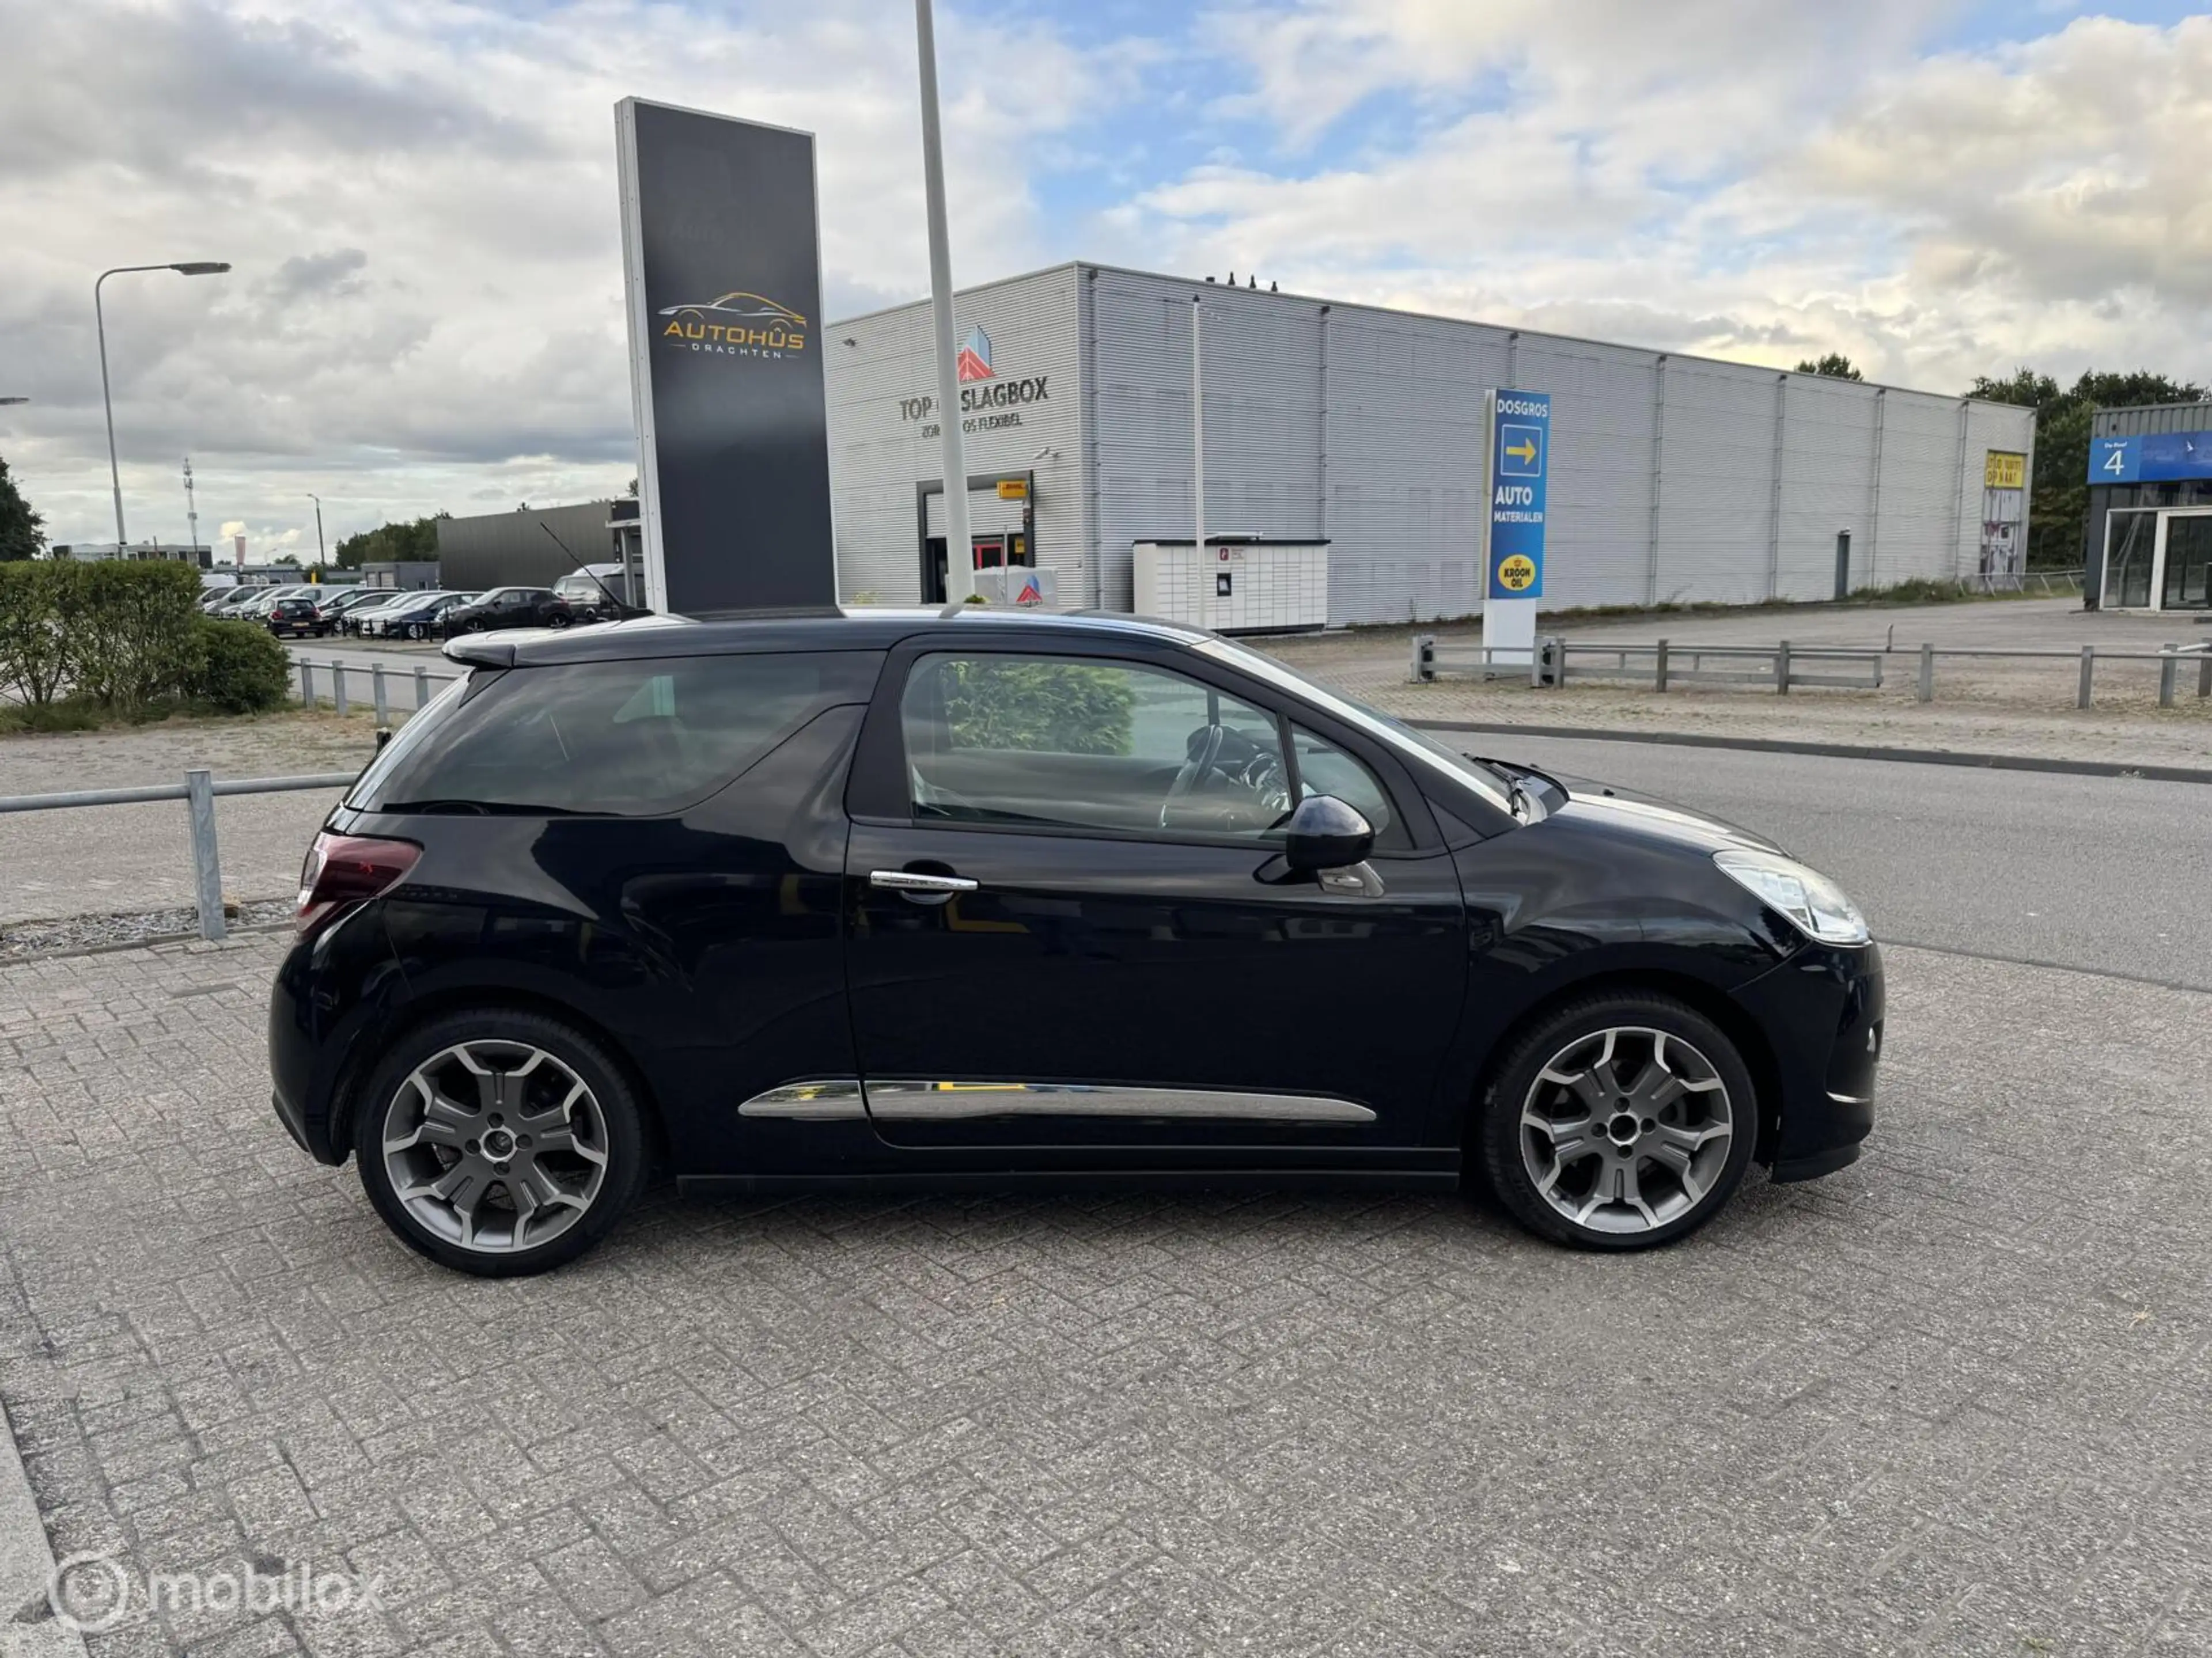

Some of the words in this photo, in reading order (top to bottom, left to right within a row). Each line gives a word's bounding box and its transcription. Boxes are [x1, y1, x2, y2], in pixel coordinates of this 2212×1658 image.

[691, 343, 782, 359] DRACHTEN
[899, 396, 932, 420] TOP
[936, 376, 1048, 412] SLAGBOX
[1497, 399, 1548, 417] DOSGROS
[2104, 450, 2125, 476] 4
[1495, 486, 1533, 506] AUTO
[1494, 511, 1544, 523] MATERIALEN
[1504, 567, 1531, 578] KROON
[1511, 578, 1524, 587] OIL
